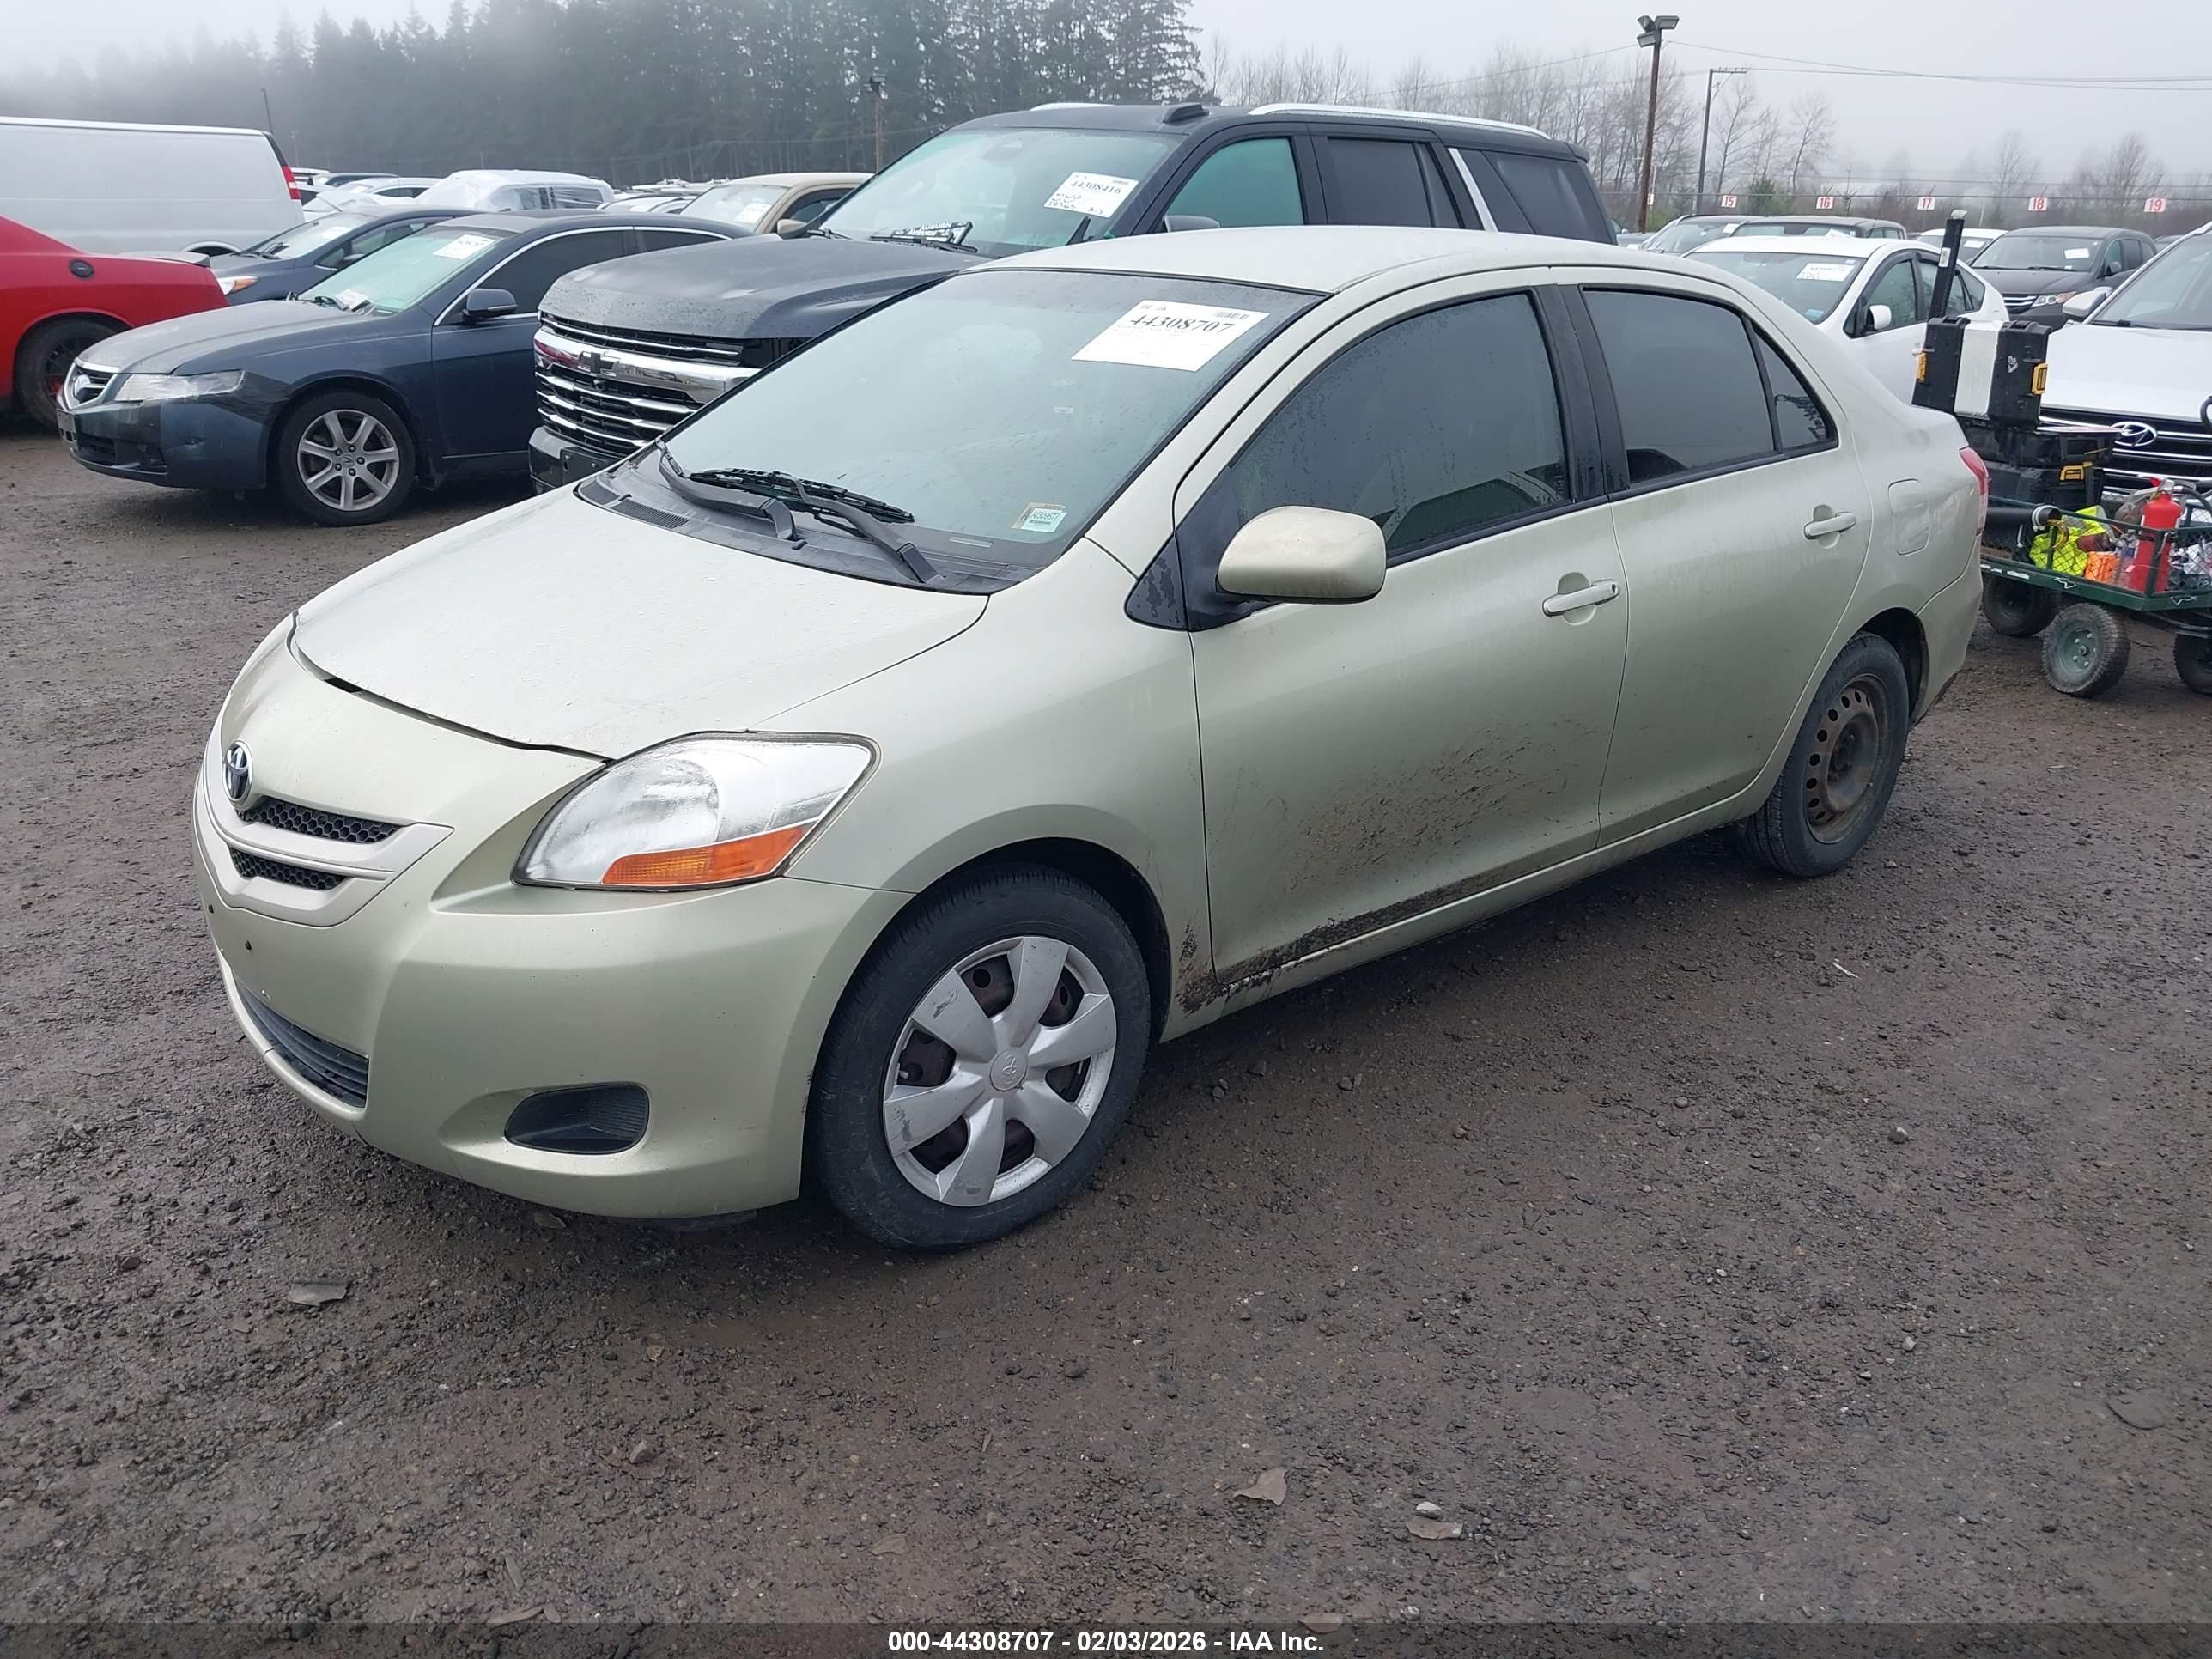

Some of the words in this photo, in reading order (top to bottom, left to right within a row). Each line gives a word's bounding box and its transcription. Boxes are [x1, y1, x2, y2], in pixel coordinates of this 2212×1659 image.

[1724, 196, 1735, 207] 15
[1819, 198, 1831, 208] 16
[1922, 198, 1933, 209] 17
[2032, 198, 2045, 210] 18
[2148, 198, 2163, 211] 19
[1130, 314, 1236, 333] 44308707
